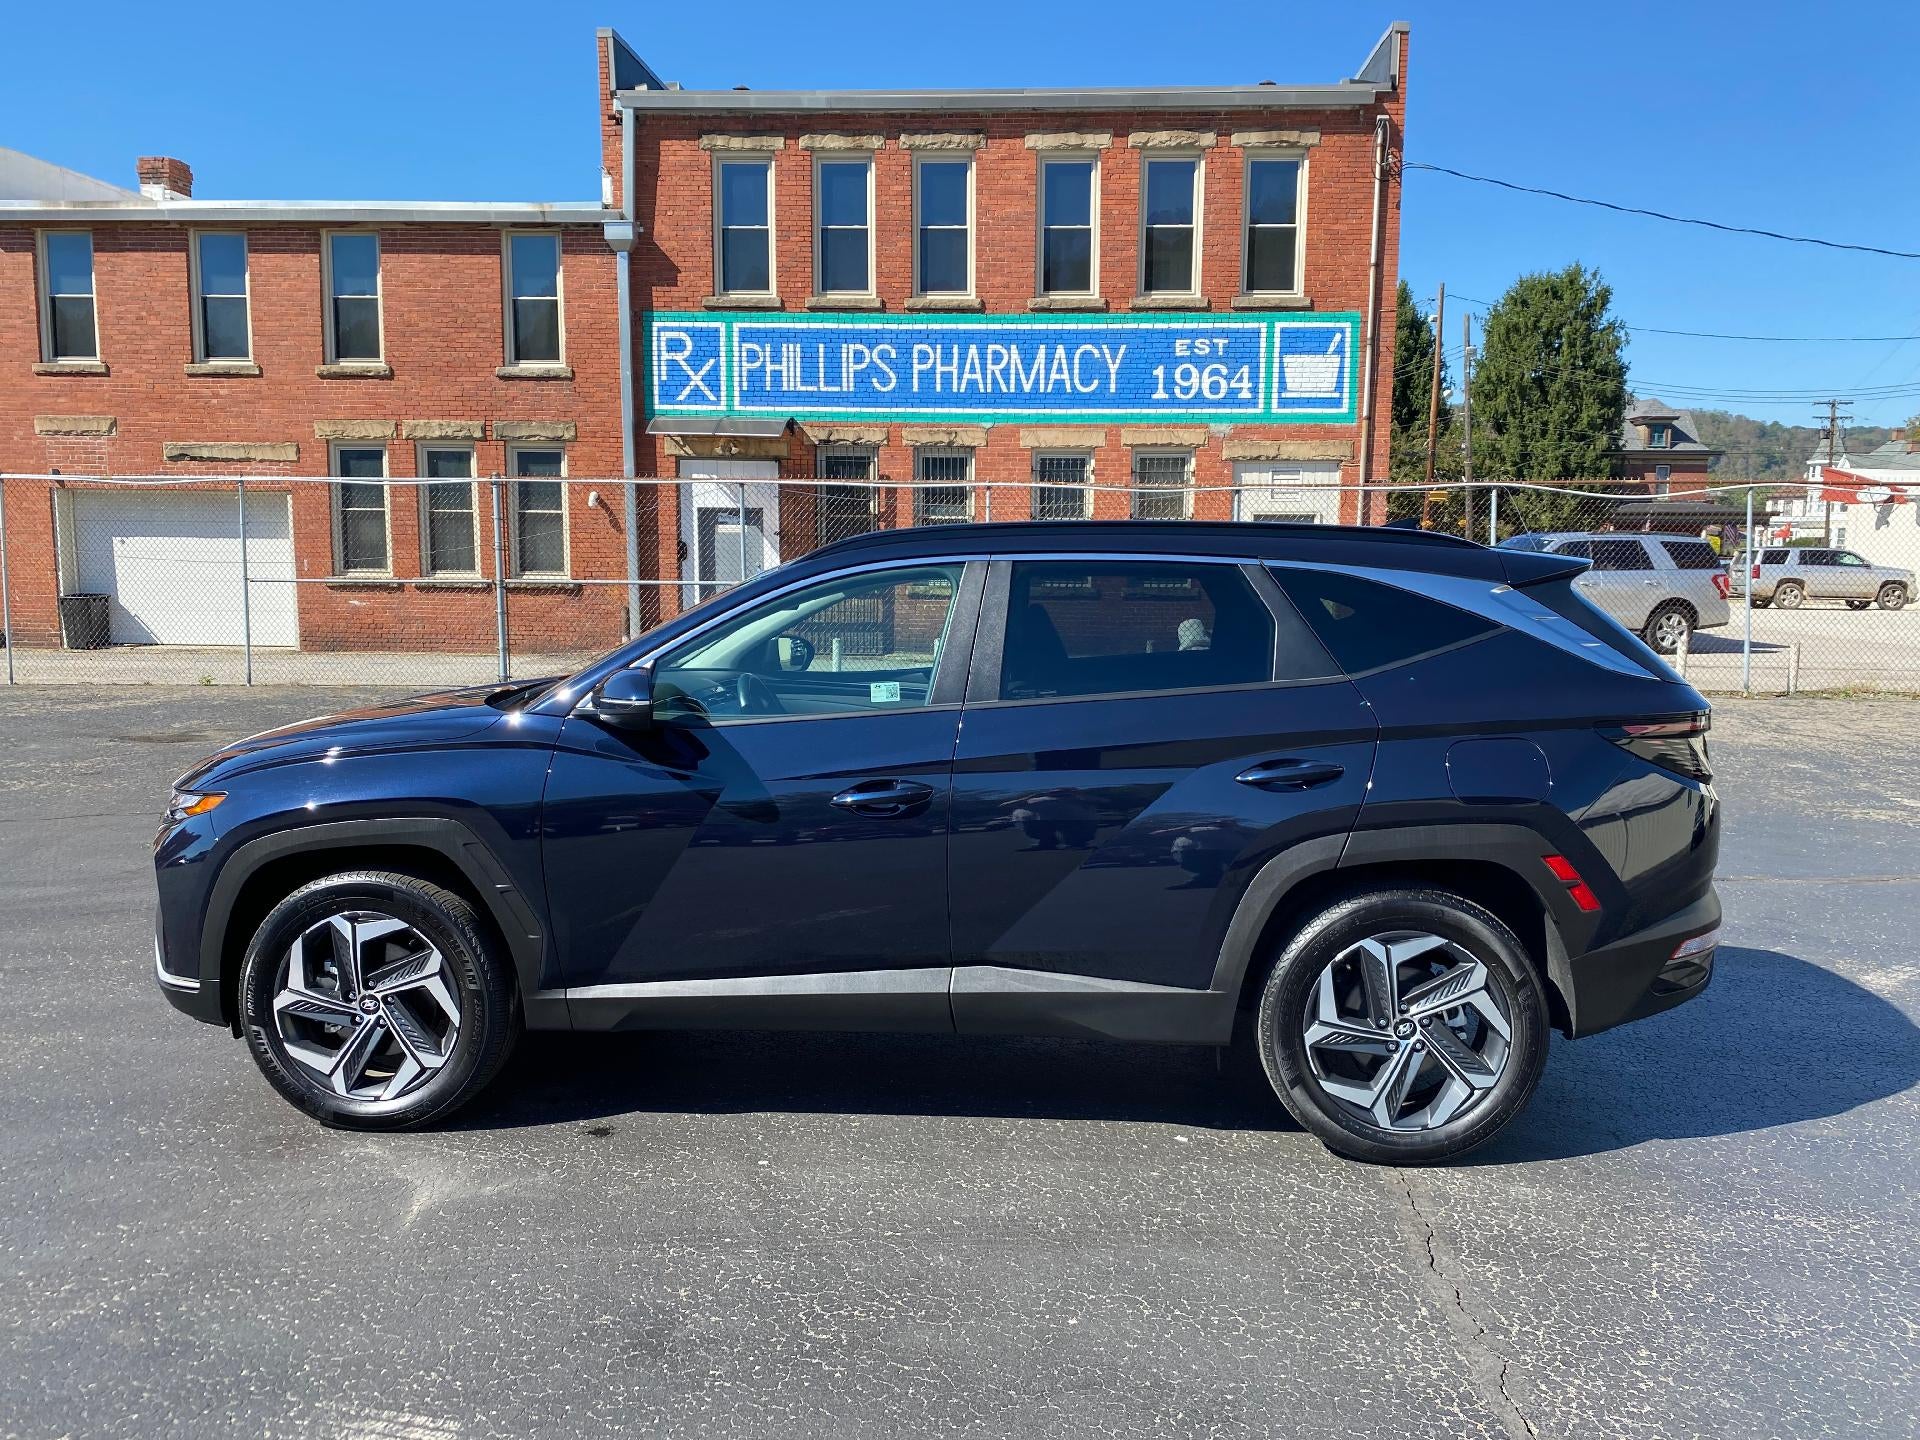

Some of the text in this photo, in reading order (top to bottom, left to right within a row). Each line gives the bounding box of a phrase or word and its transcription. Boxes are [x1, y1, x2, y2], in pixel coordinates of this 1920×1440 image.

[741, 343, 1127, 394] PHILLIPS PHARMACY
[1174, 338, 1229, 357] EST
[1151, 363, 1252, 400] 1964
[246, 969, 257, 1017] PRIMACY
